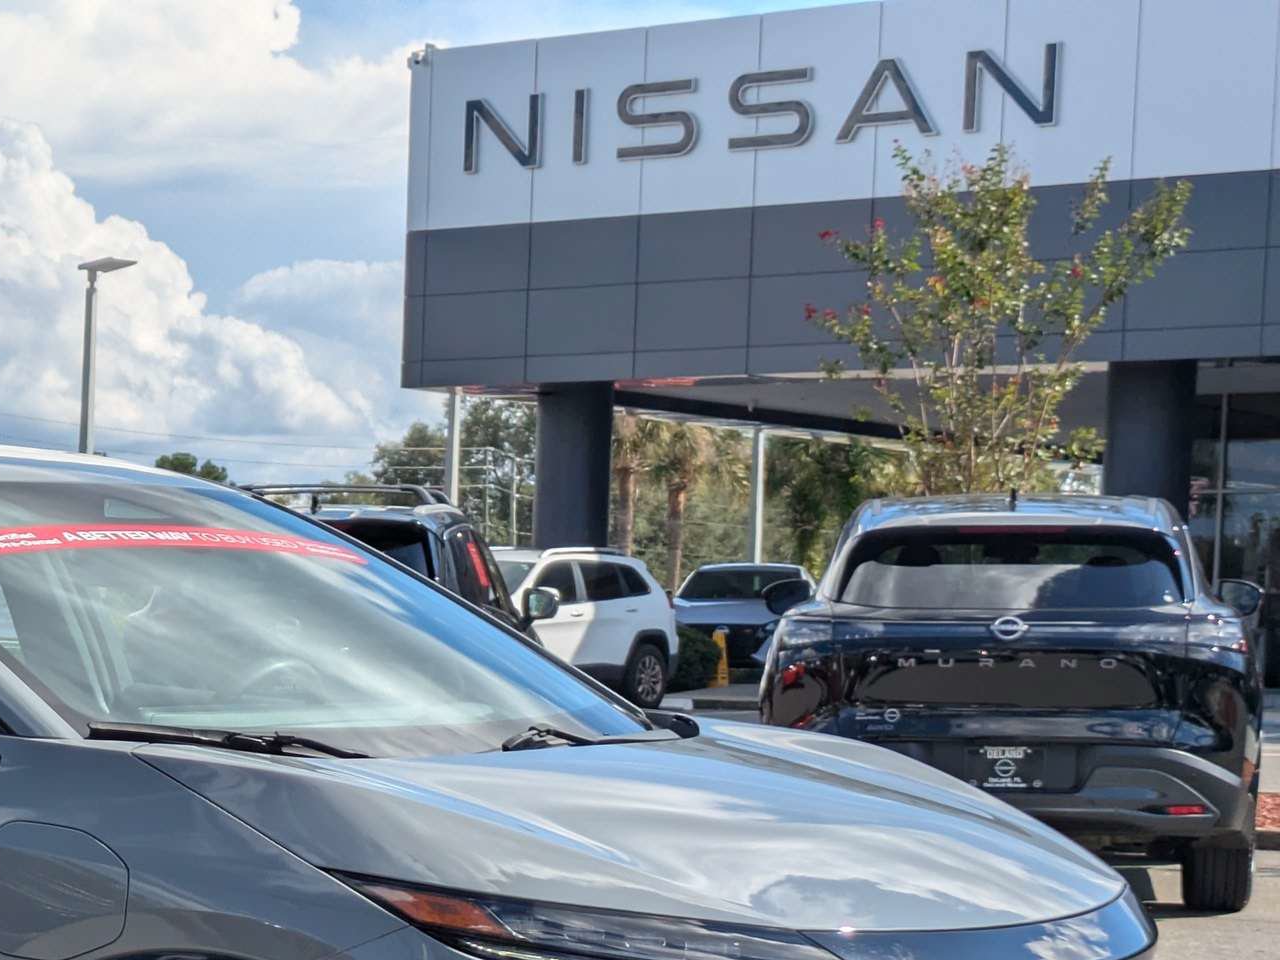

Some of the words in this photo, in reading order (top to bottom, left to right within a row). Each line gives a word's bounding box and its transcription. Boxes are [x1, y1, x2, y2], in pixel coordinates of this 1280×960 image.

[463, 41, 1064, 175] NISSAN
[62, 531, 77, 542] A
[75, 530, 156, 541] BETTER
[152, 531, 193, 541] WAY
[897, 657, 1118, 669] MURANO
